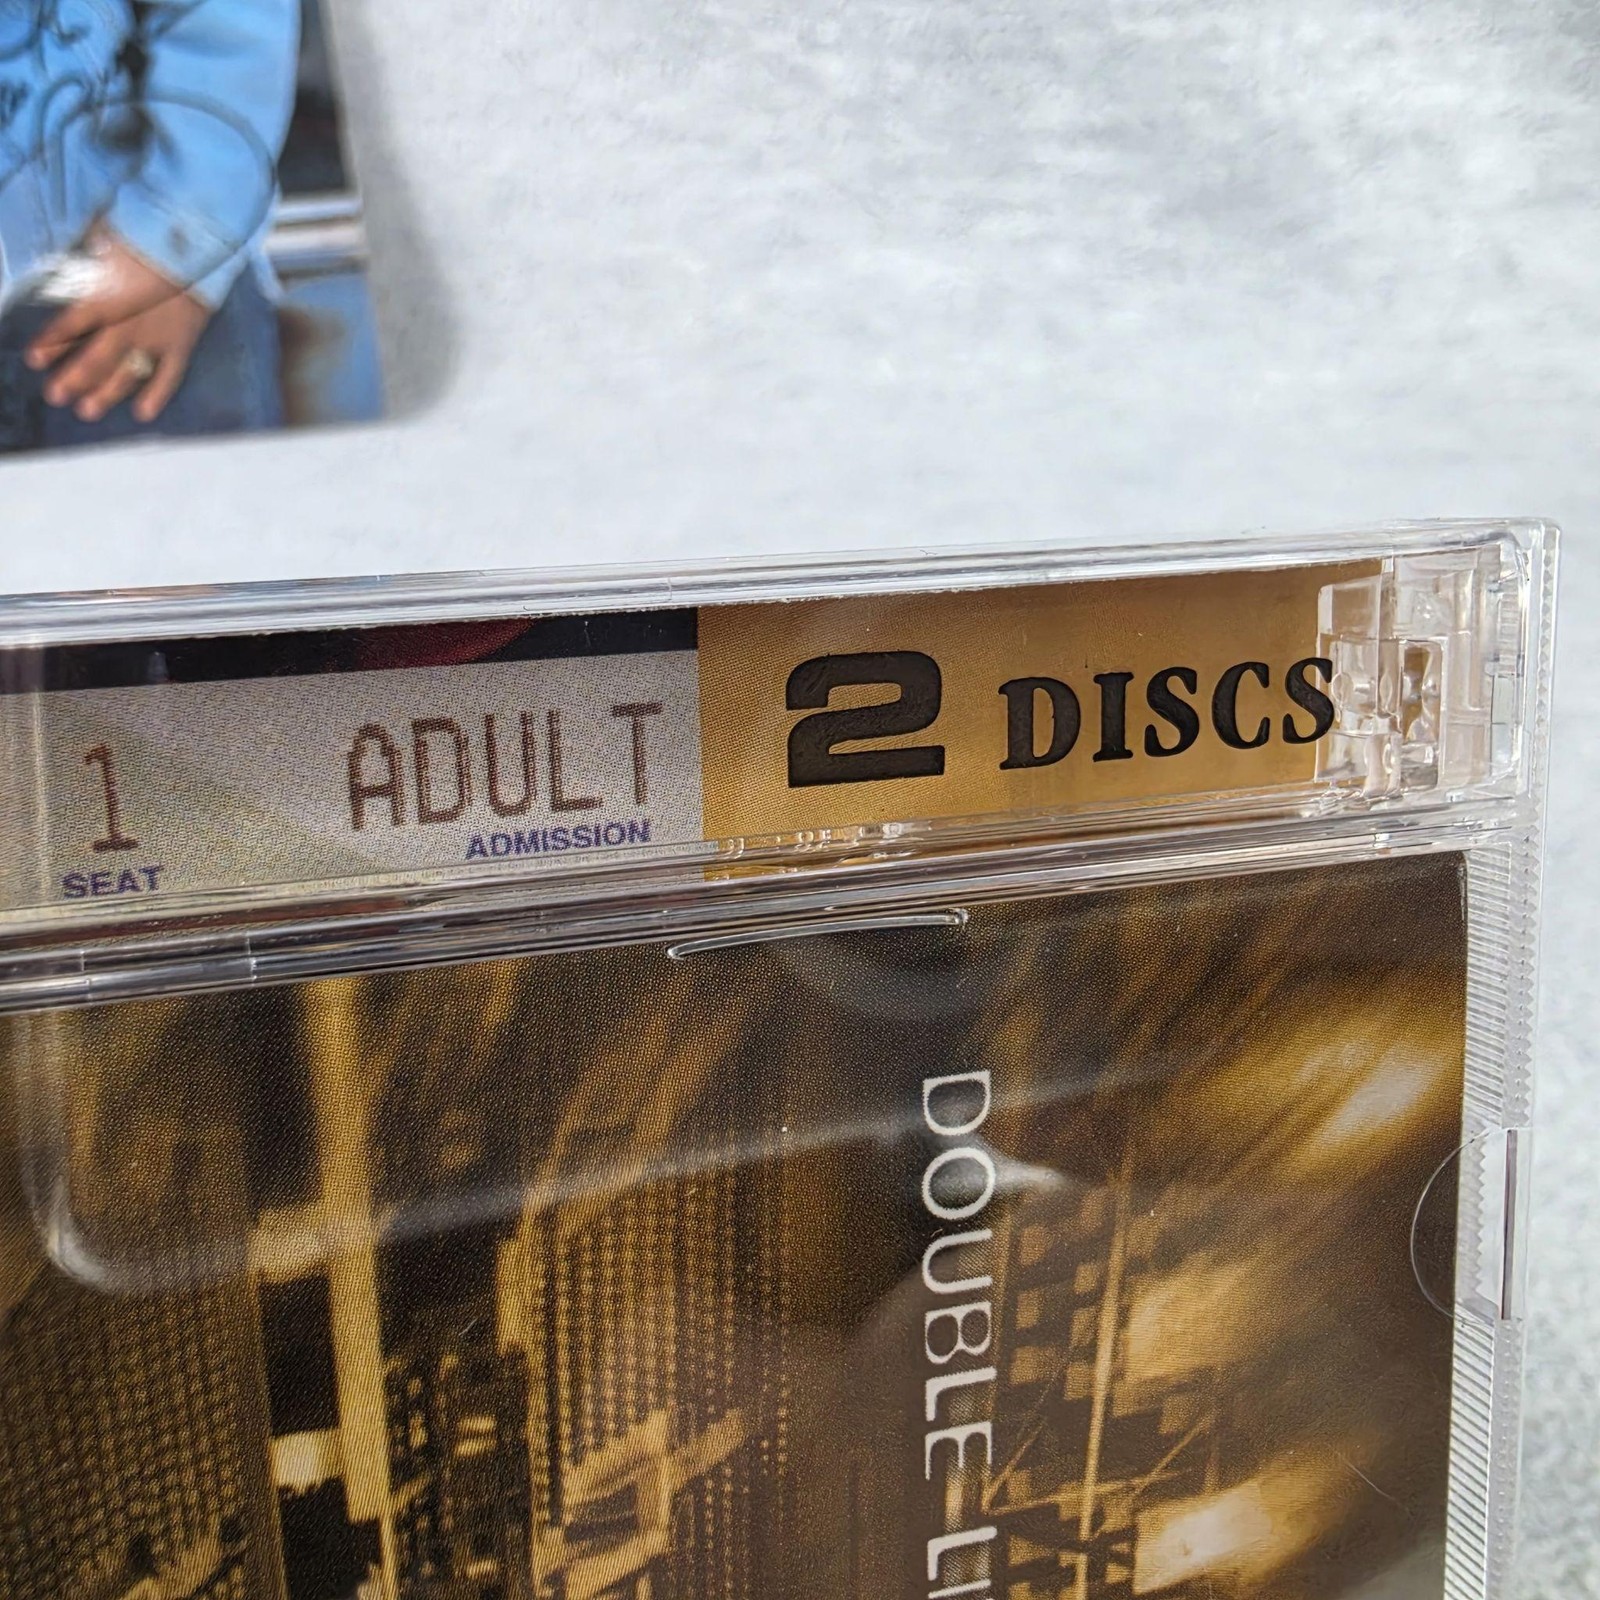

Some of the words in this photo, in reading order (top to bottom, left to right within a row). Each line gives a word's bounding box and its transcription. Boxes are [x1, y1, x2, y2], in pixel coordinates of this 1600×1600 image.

[84, 743, 138, 853] 1
[347, 702, 662, 831] ADULT
[786, 650, 944, 787] 2
[998, 657, 1336, 769] DISCS
[64, 867, 163, 898] SEAT
[466, 820, 651, 860] ADMISSION
[922, 1070, 997, 1480] DOUBLE
[927, 1526, 997, 1600] LI
